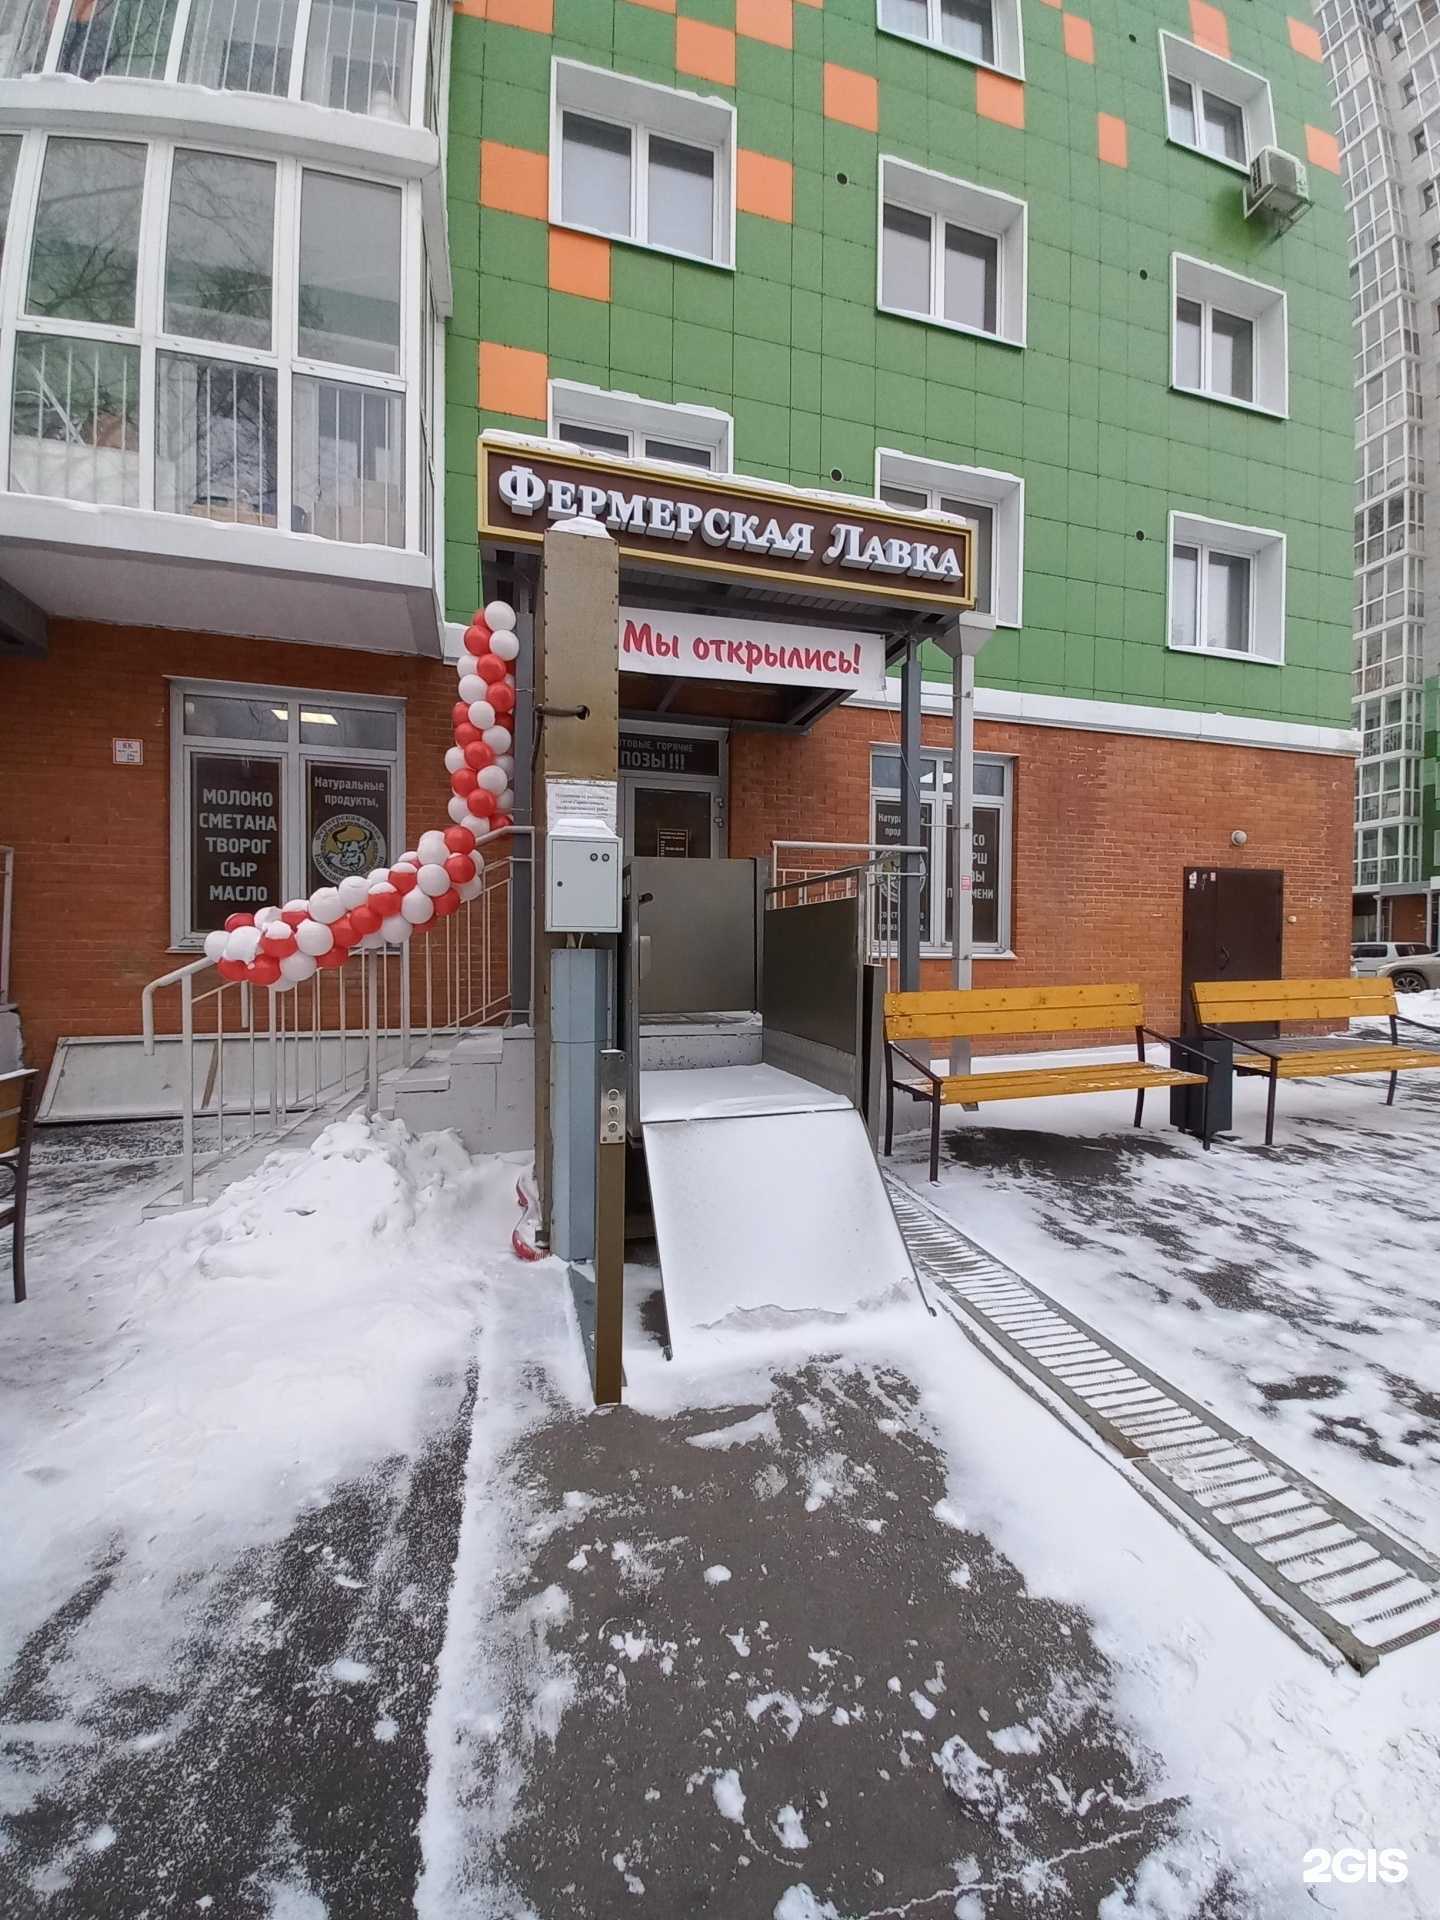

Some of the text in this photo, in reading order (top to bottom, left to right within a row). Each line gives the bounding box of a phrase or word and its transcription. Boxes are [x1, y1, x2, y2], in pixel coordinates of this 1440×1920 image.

[623, 619, 861, 675] Мы открылись!
[314, 776, 385, 792] Натуральные
[202, 788, 273, 807] МОЛОКО
[199, 812, 278, 831] СМЕТАНА
[205, 836, 272, 855] ТВОРОГ
[220, 861, 257, 877] СЫР
[209, 884, 268, 902] МАСЛО
